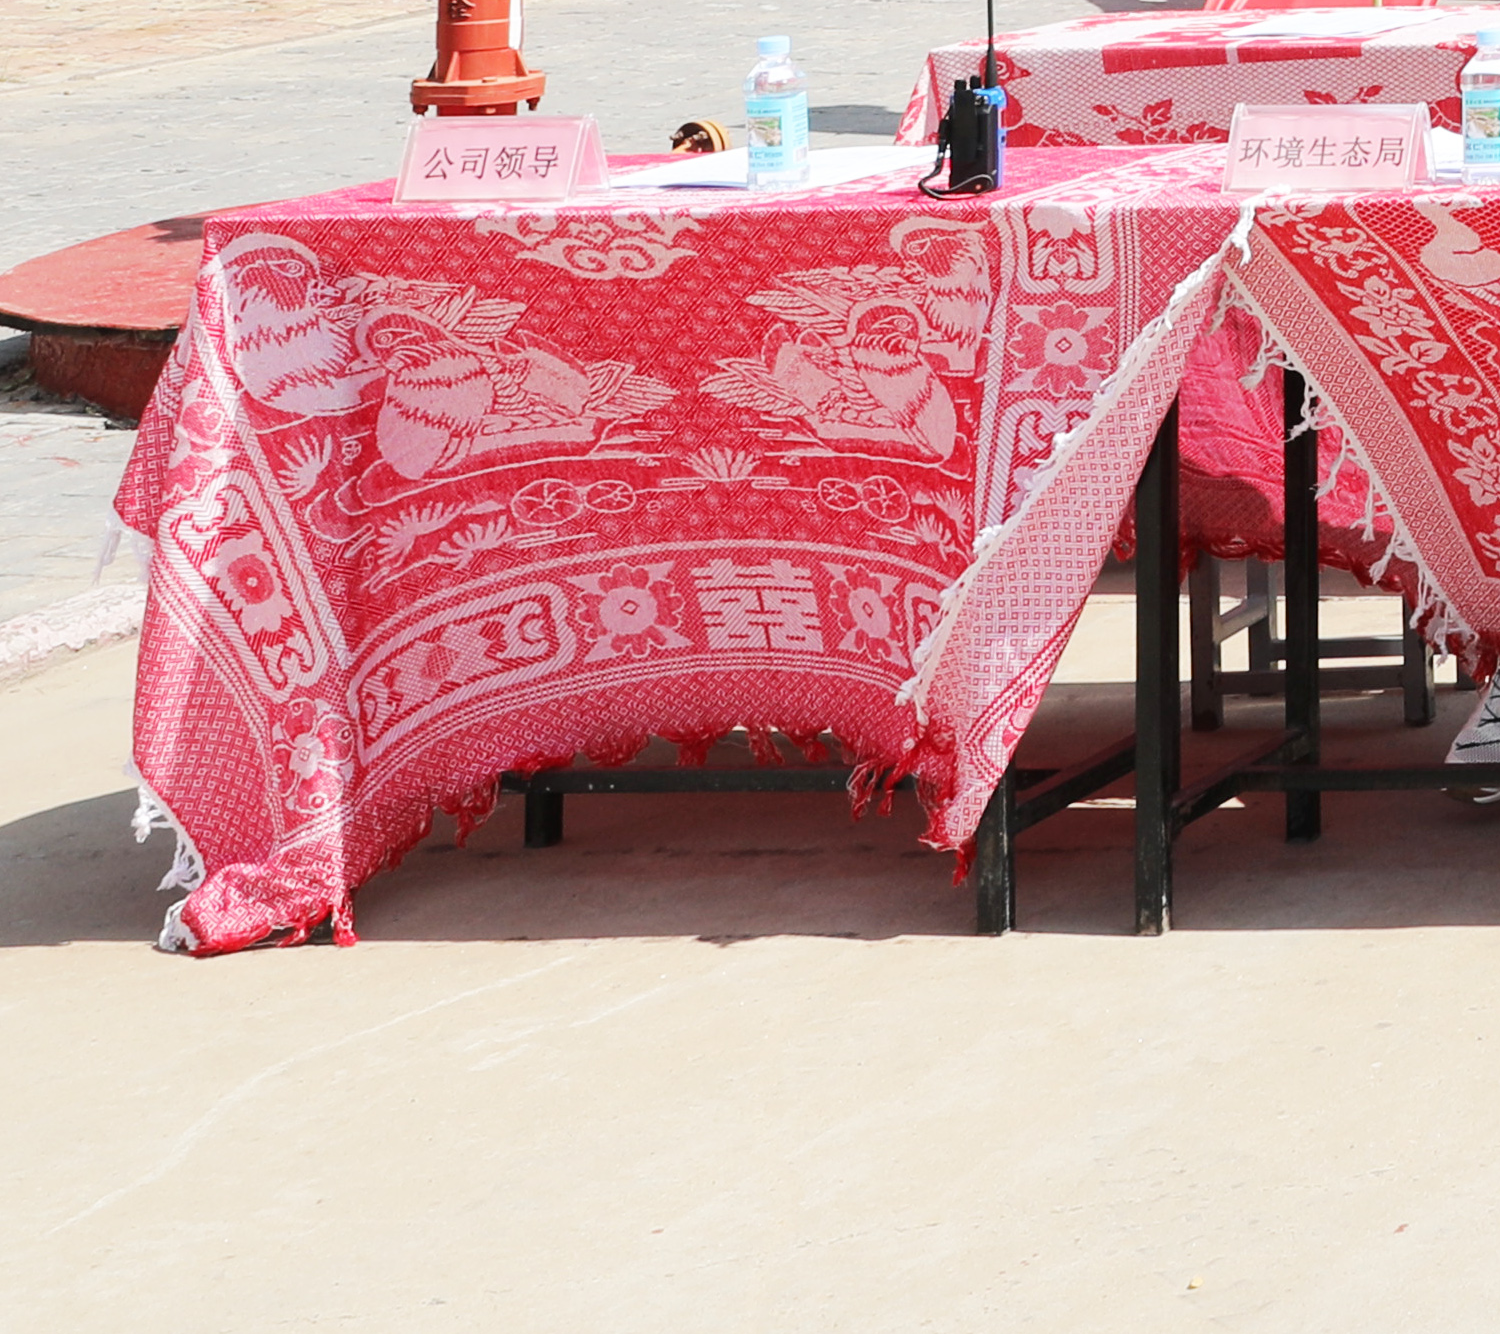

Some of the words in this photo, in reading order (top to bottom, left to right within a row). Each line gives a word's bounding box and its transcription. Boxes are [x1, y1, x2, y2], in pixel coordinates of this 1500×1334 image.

[422, 145, 561, 182] 公司领导
[1238, 136, 1406, 169] 环境生态局
